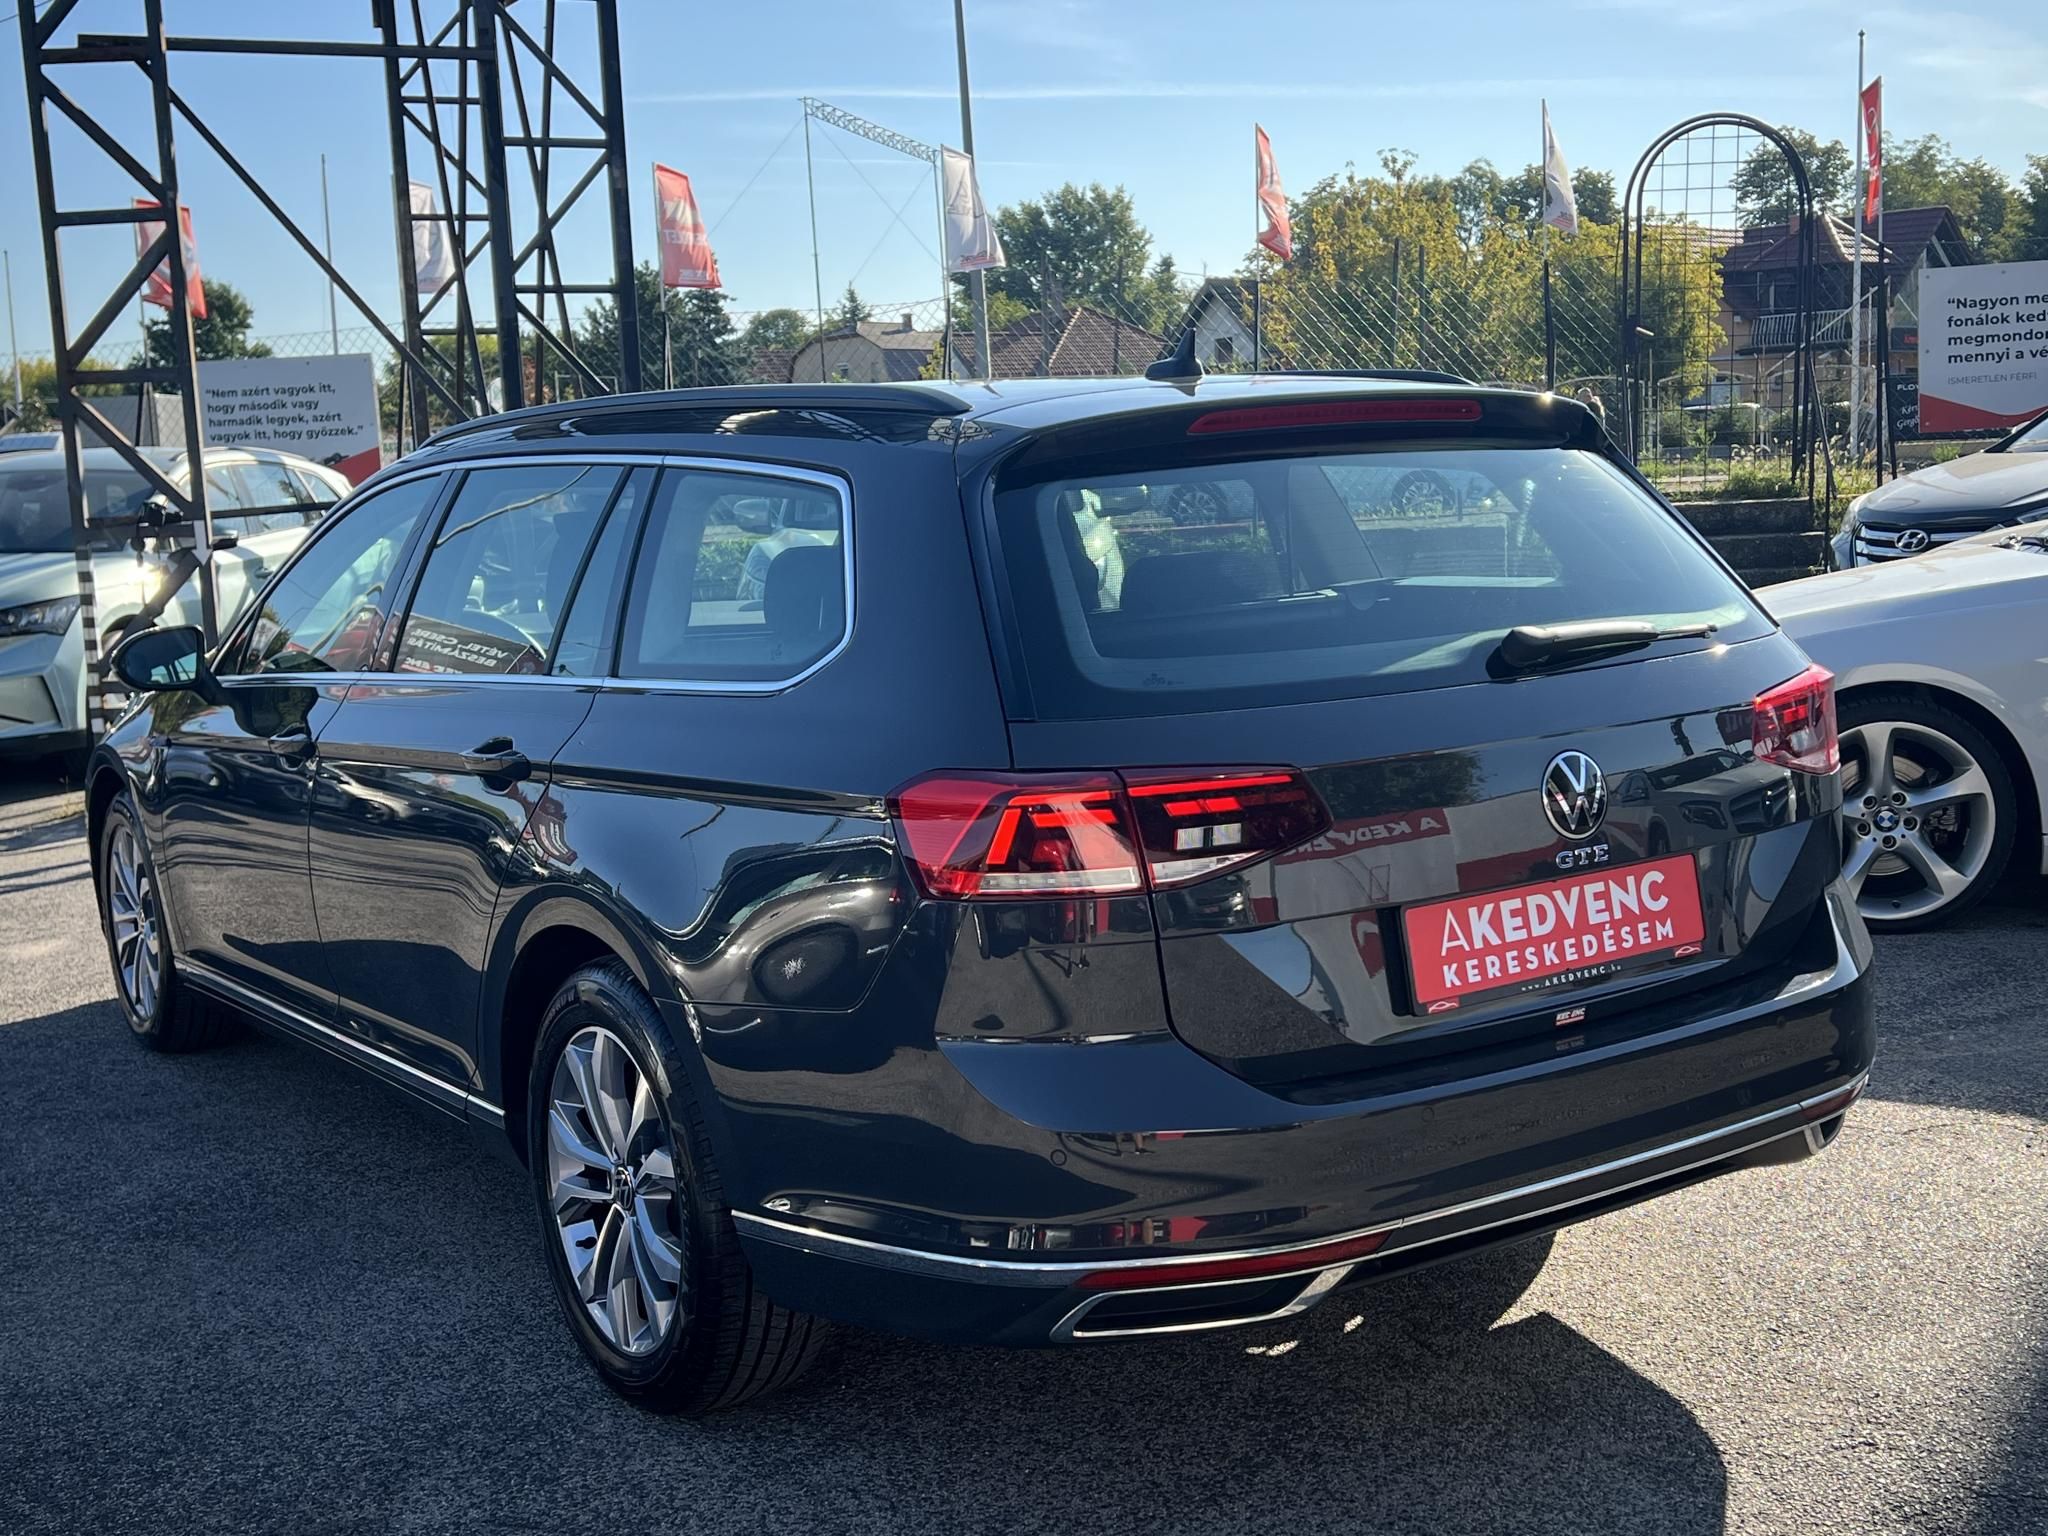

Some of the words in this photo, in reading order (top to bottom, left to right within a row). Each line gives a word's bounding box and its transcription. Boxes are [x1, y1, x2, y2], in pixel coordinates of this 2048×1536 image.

[1947, 312, 2010, 328] fonálok
[2016, 309, 2048, 324] ked
[1948, 347, 2010, 364] mennyi
[2015, 350, 2024, 360] a
[1947, 372, 2008, 385] ISMERETLEN
[2010, 371, 2037, 382] FÉRFI
[241, 386, 270, 397] azért
[274, 384, 315, 398] vagyok
[318, 382, 336, 395] itt,
[207, 403, 236, 415] hogy
[239, 401, 288, 412] második
[291, 399, 320, 411] vagy
[208, 414, 263, 428] harmadik
[266, 411, 309, 425] legyek,
[312, 412, 342, 423] azért
[210, 429, 251, 443] vagyok
[254, 428, 271, 441] itt,
[274, 429, 303, 440] hogy
[1555, 844, 1609, 869] GTE
[1443, 918, 1675, 988] KERESKEDÉSEM
